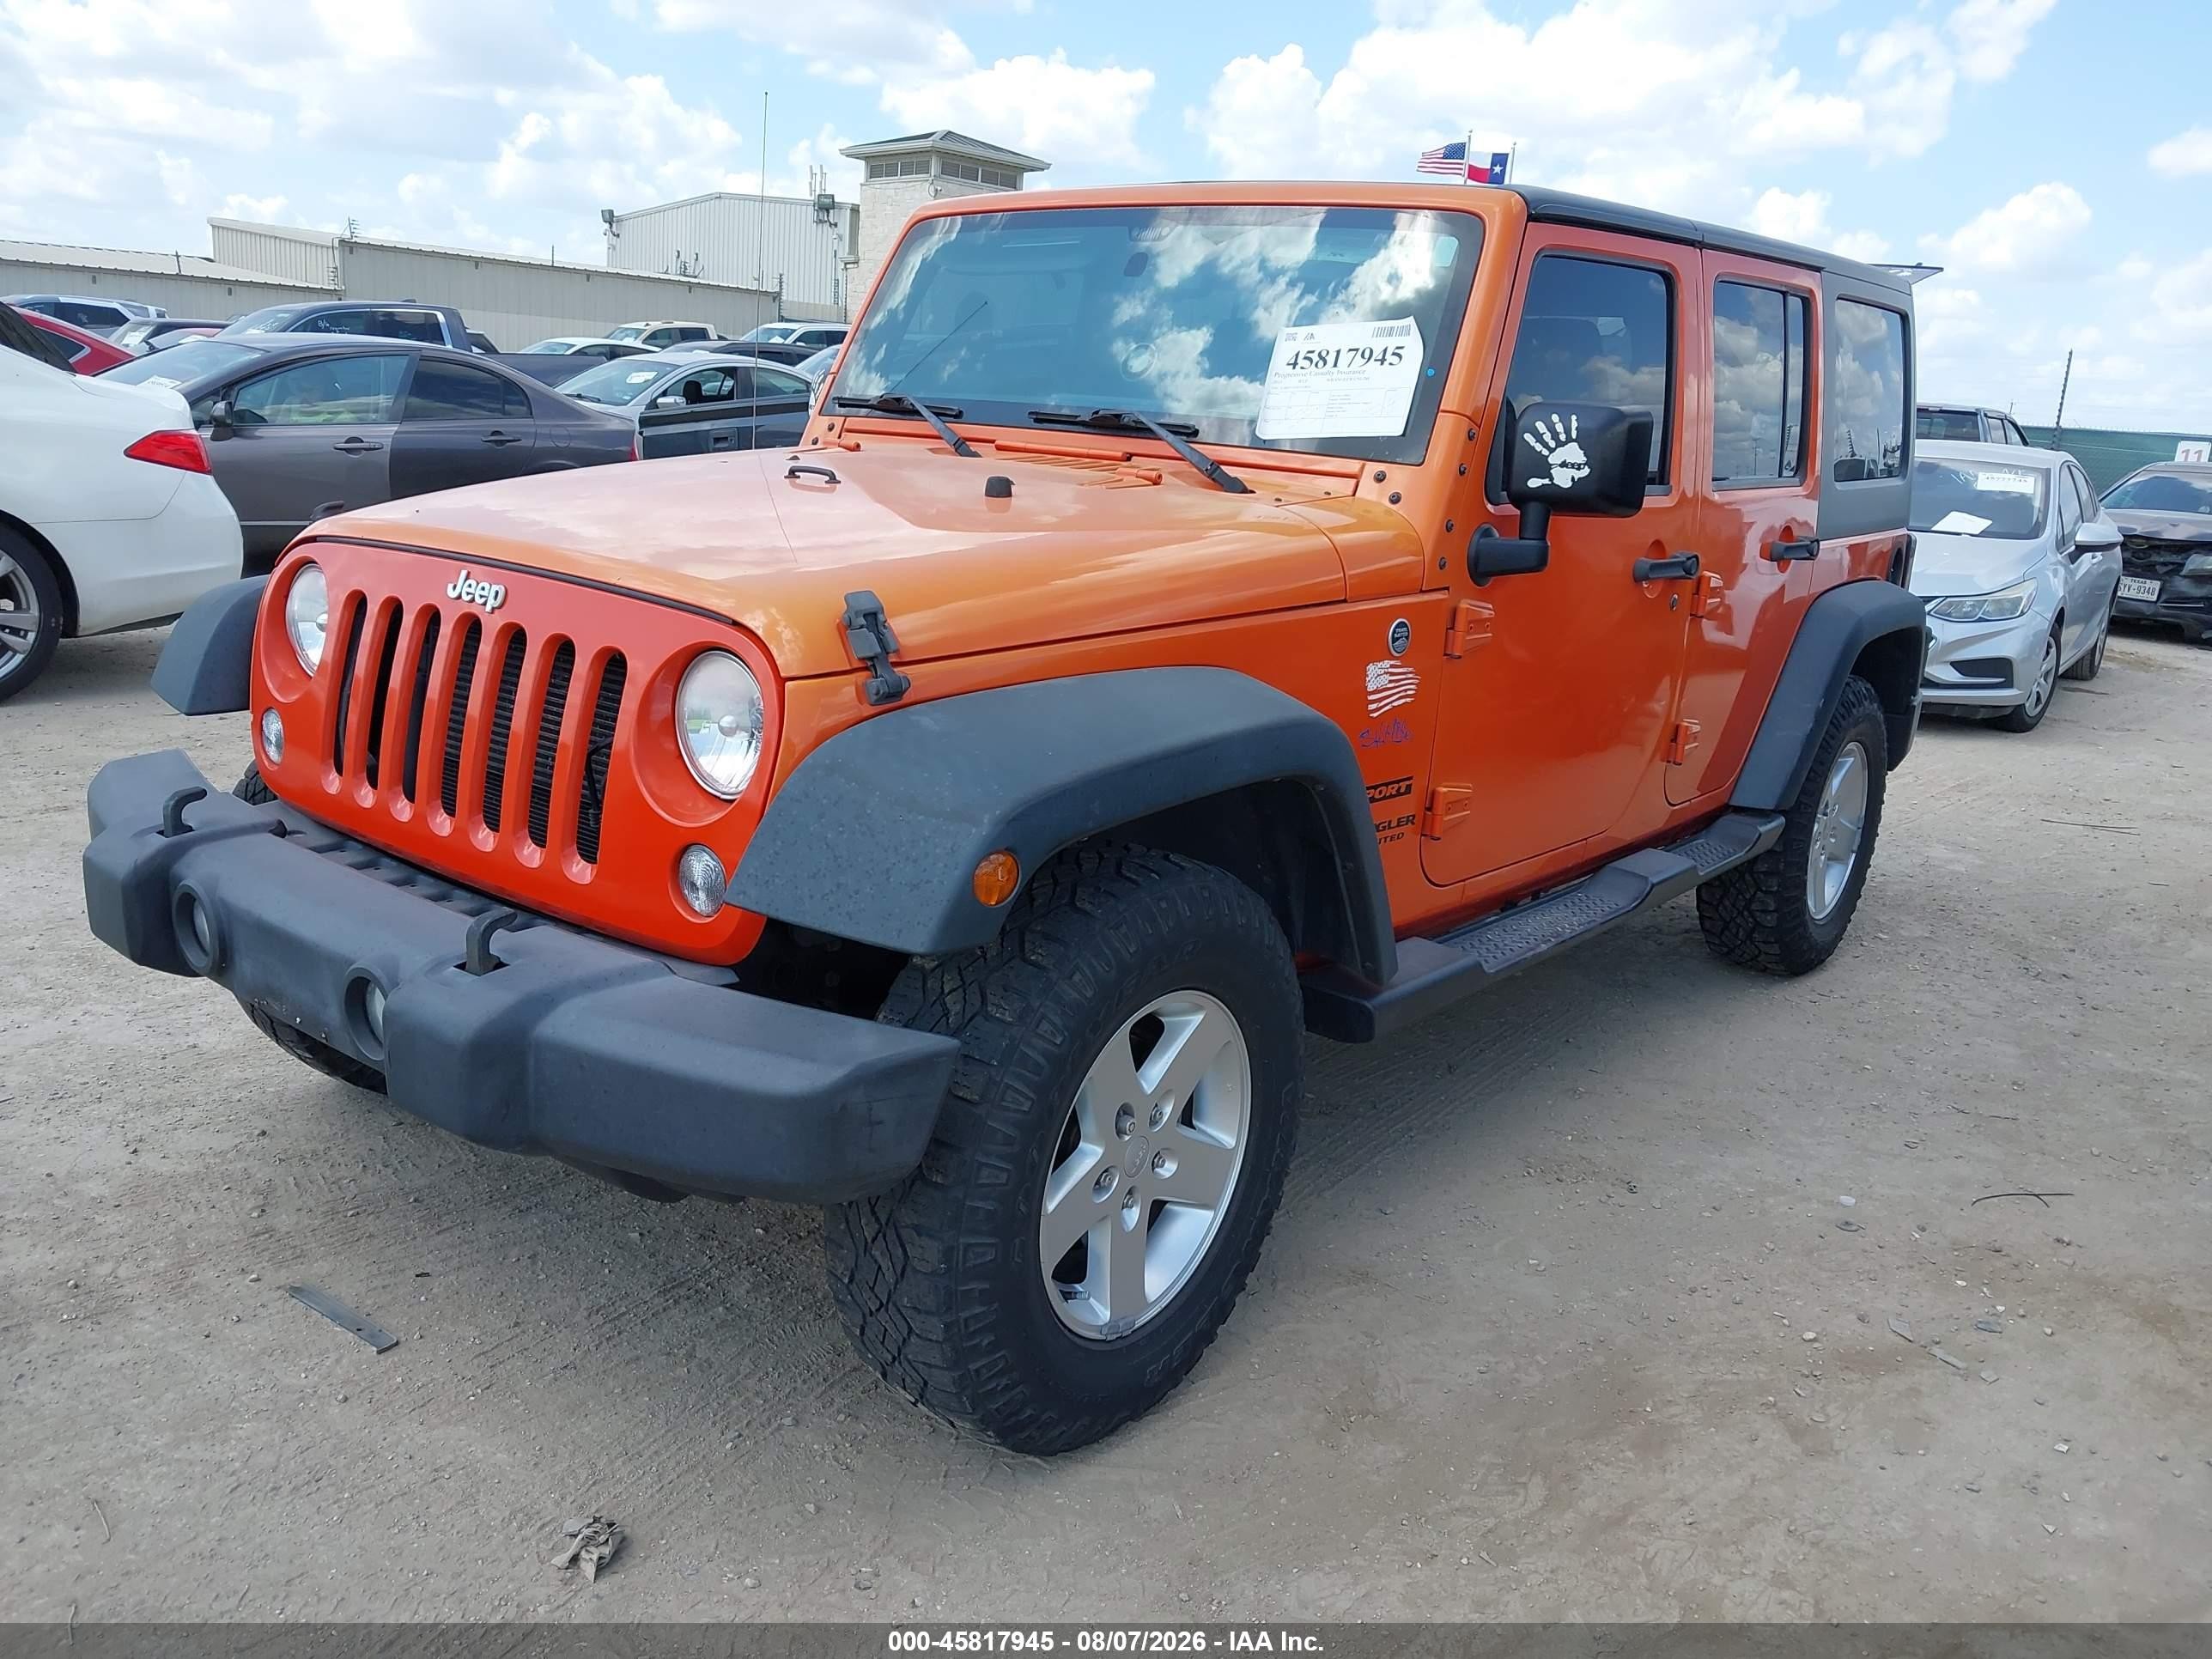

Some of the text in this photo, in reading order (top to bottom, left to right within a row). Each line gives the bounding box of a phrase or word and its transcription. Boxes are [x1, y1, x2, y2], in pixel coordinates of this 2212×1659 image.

[1285, 346, 1406, 370] 45817945
[2181, 449, 2203, 462] 11
[447, 569, 507, 613] Jeep
[1366, 780, 1413, 799] PORT
[1375, 814, 1416, 832] GLER
